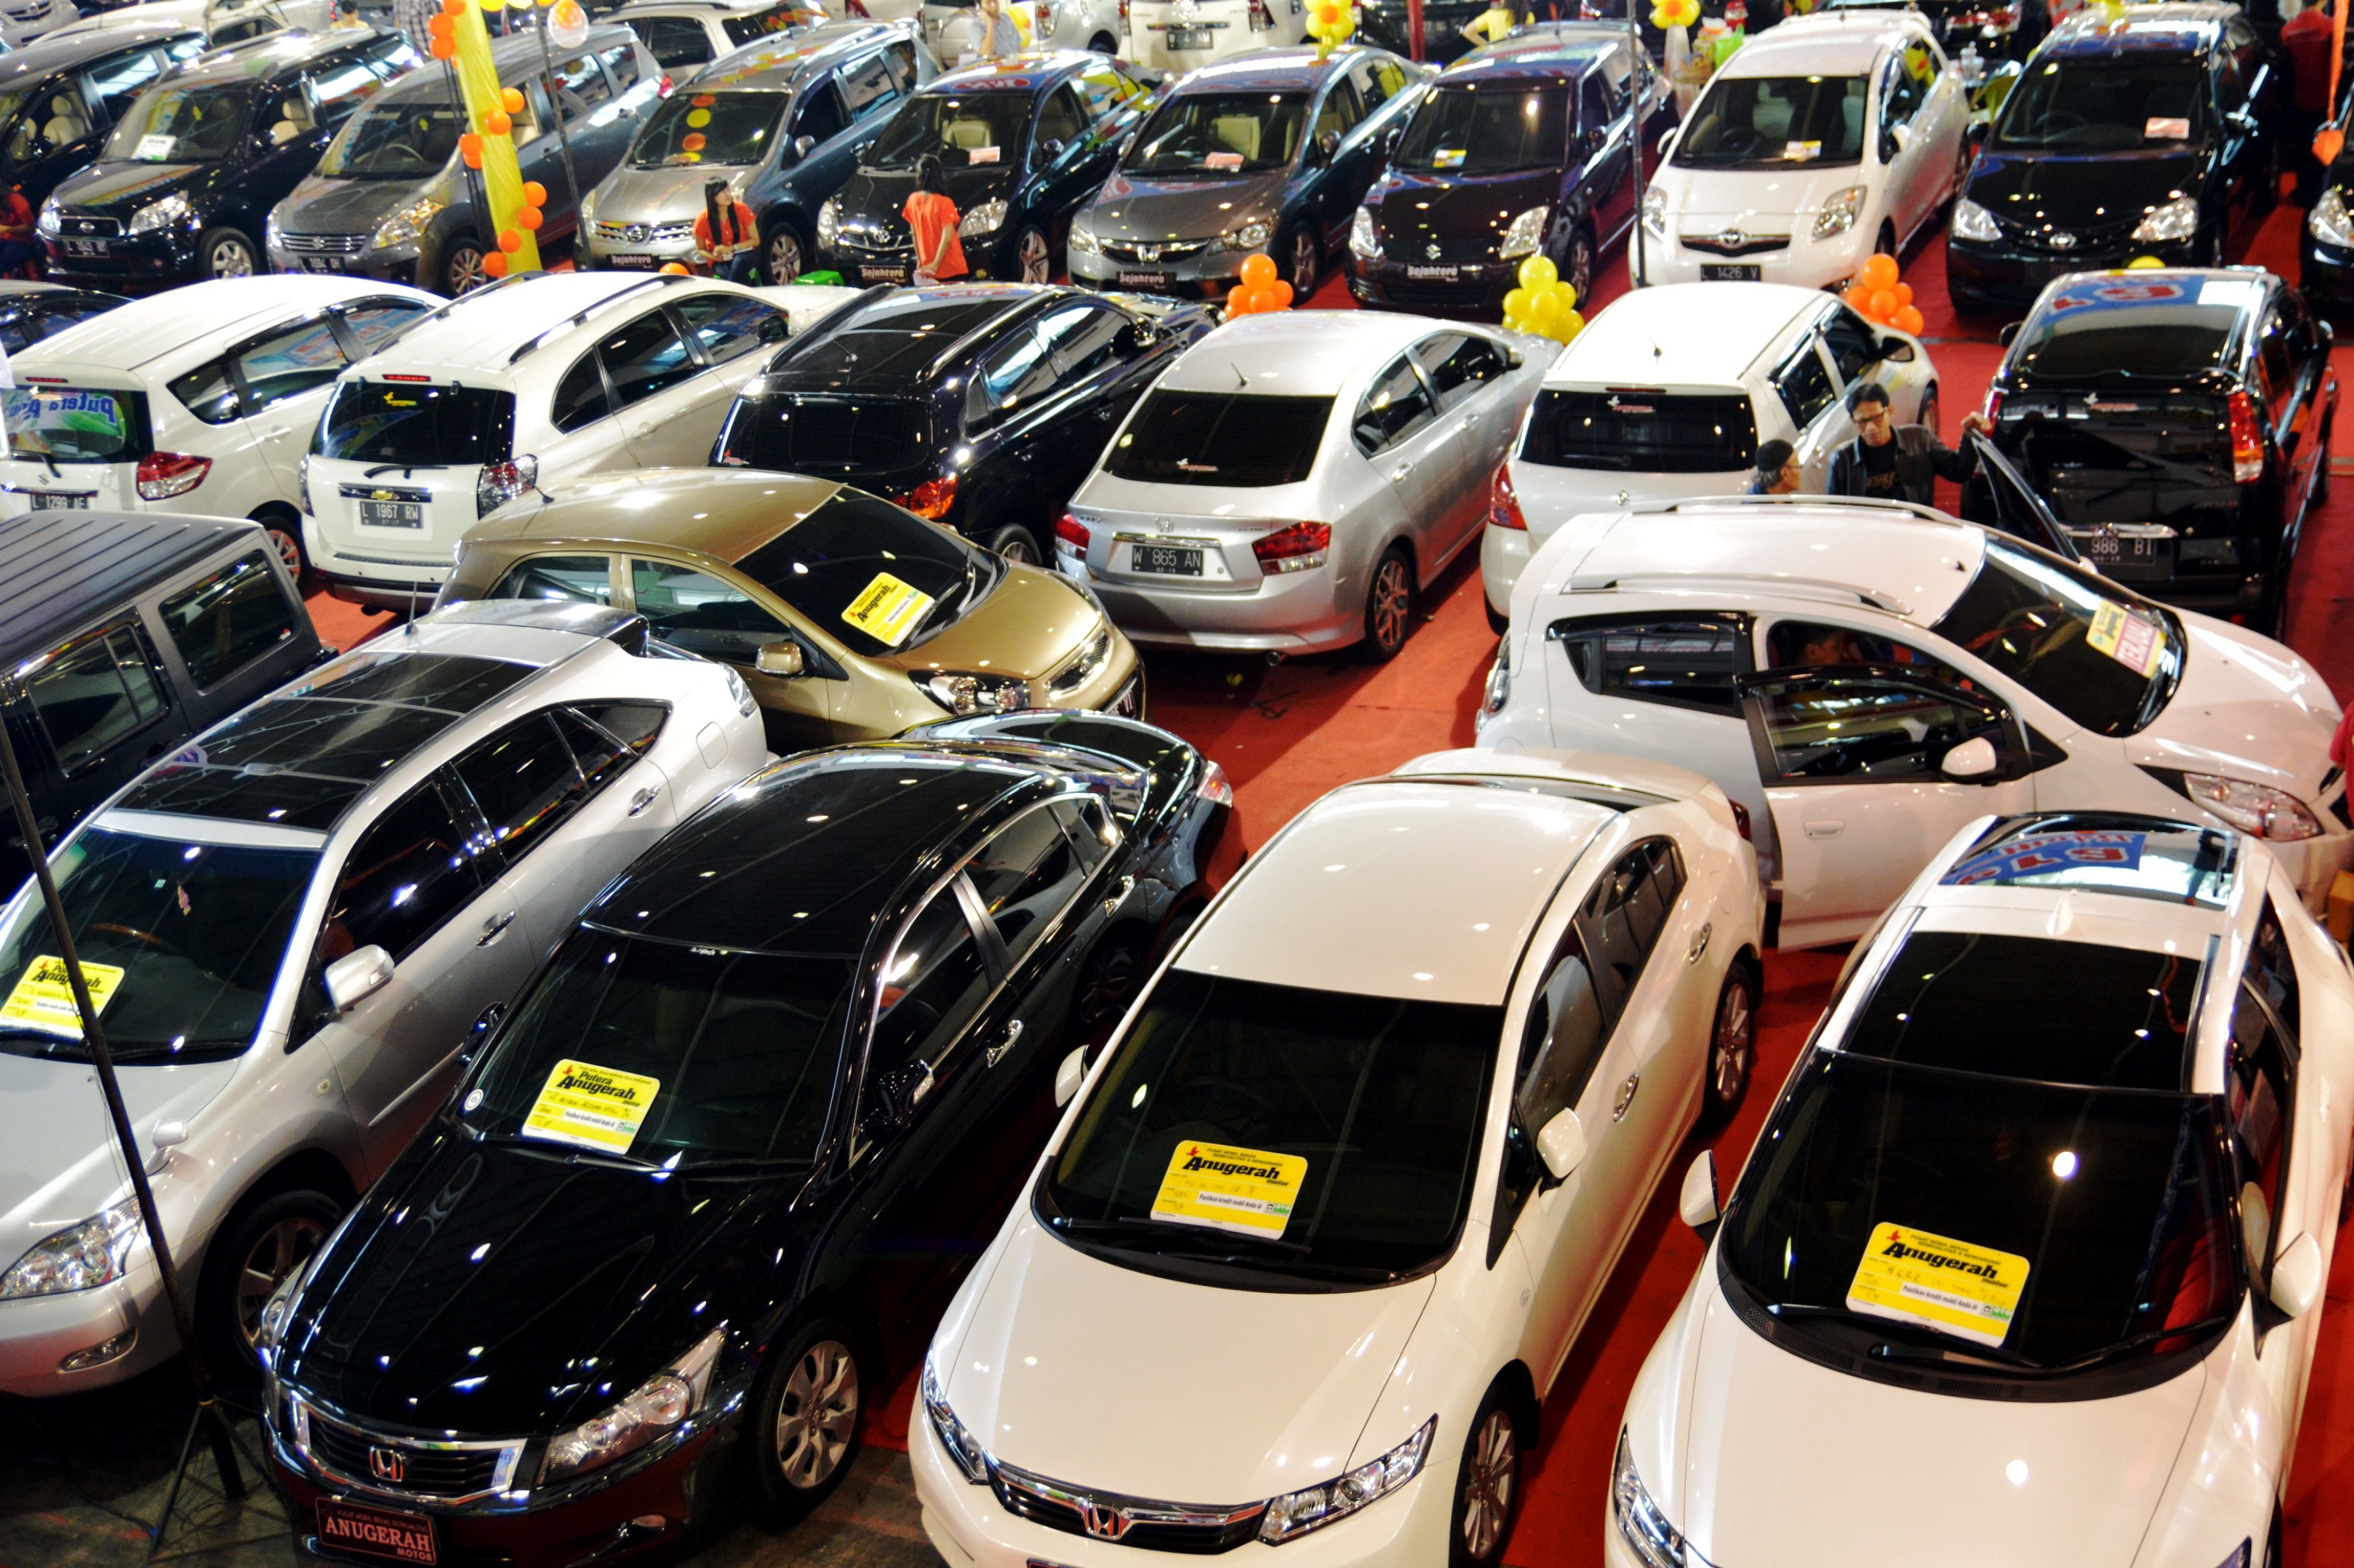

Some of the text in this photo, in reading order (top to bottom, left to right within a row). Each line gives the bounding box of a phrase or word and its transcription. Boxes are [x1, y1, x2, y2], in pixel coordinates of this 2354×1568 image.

[861, 268, 904, 278] Sejahtera
[1119, 273, 1165, 284] Sejahtera
[1407, 266, 1458, 278] Sejahtera
[1702, 266, 1758, 279] L 1426 V
[32, 495, 40, 508] L
[46, 495, 68, 510] 1299
[361, 503, 419, 520] L 1967 RW
[2091, 537, 2119, 554] 986
[1133, 548, 1201, 568] W 865 AN
[857, 584, 891, 623] Anugerah
[31, 969, 102, 988] Anugah
[578, 1071, 613, 1085] Putera
[556, 1075, 637, 1100] Anugerah
[1182, 1156, 1280, 1180] Anugerah
[1266, 1178, 1289, 1187] motor
[1199, 1194, 1218, 1202] Pastikan
[1218, 1197, 1233, 1205] kredit
[1233, 1199, 1245, 1207] mobil
[1882, 1241, 1998, 1279] Anugerah
[1981, 1277, 2009, 1289] motor
[1902, 1285, 1978, 1311] Pastikan kredit mobil Anda di
[1992, 1307, 2011, 1316] OTO
[325, 1516, 431, 1553] ANUGERAH
[397, 1547, 433, 1561] MOTOR
